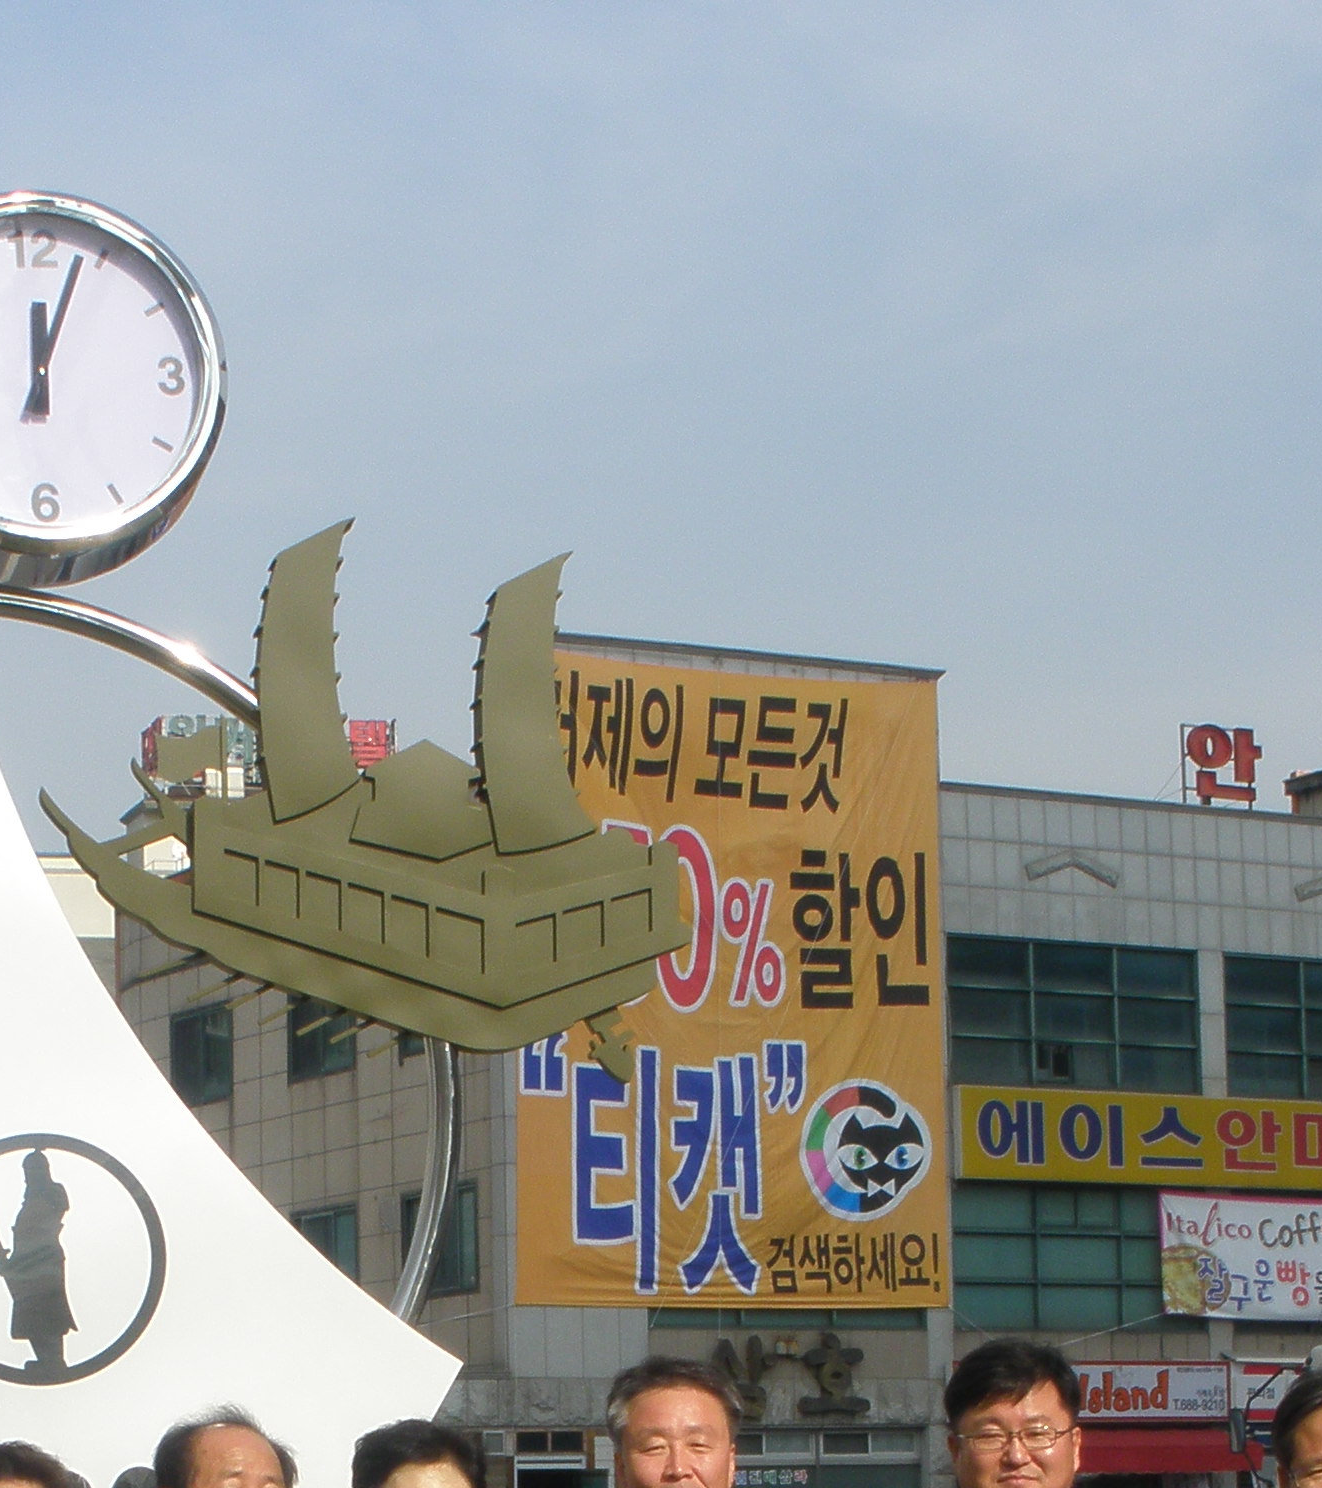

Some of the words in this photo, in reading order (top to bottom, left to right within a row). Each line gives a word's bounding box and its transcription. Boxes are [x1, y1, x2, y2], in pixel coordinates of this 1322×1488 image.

[6, 229, 59, 270] 12
[157, 356, 185, 396] 3
[30, 483, 61, 522] 6
[693, 694, 848, 814] 모든것
[601, 819, 786, 1014] 0%
[788, 849, 930, 1010] 할인
[1164, 1202, 1253, 1247] Italico
[766, 1231, 941, 1294] 검색하세요!
